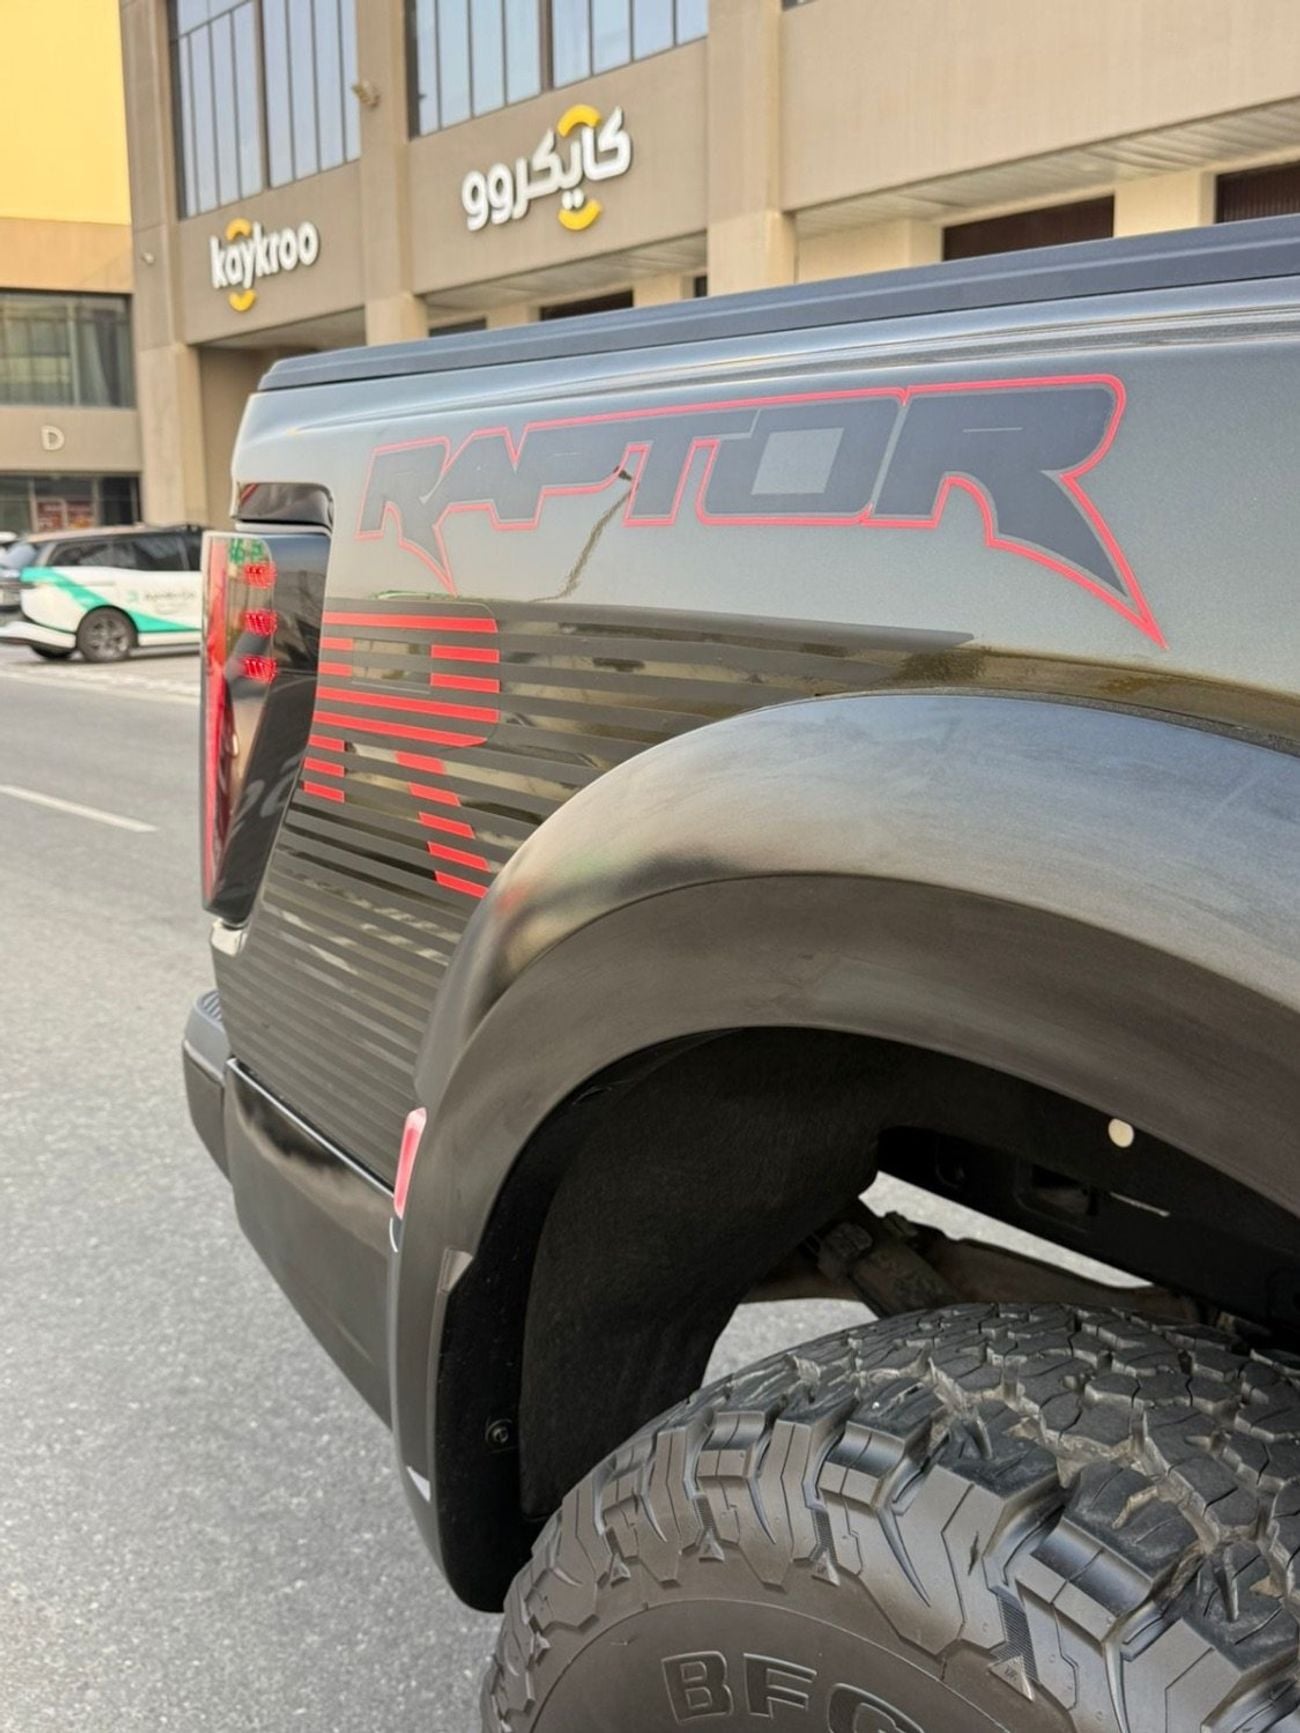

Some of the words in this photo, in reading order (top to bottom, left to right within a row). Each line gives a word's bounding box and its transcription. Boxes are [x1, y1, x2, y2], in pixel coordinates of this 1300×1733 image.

[461, 106, 631, 231] كايكروو
[209, 220, 319, 289] kaykroo
[41, 425, 65, 451] D
[357, 374, 1167, 648] RAPTOR
